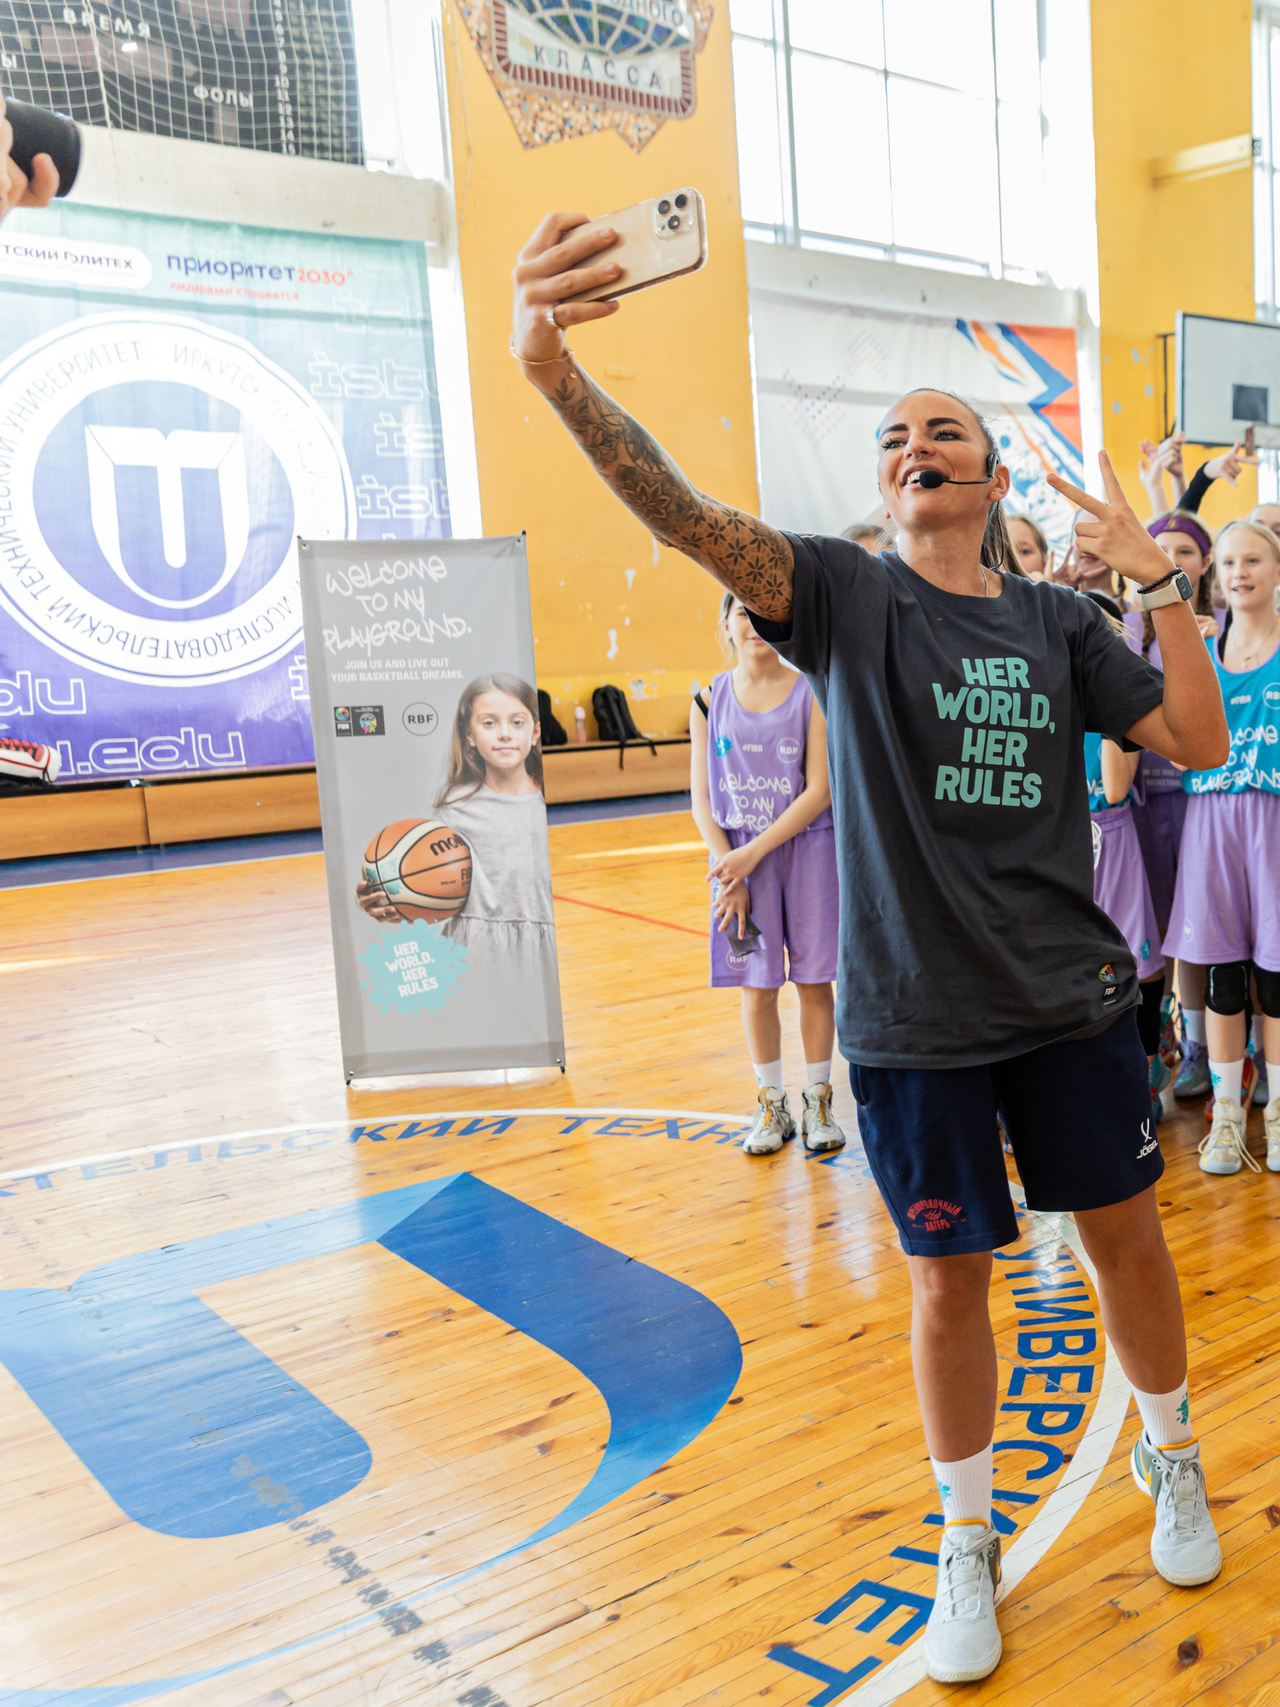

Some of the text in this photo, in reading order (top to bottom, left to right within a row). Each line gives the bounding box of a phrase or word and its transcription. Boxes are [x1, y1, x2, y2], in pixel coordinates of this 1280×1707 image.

[63, 8, 151, 38] ВРЕМЯ
[534, 45, 662, 89] КЛАССА
[193, 84, 252, 108] ФОЛЫ
[355, 586, 425, 617] TO MY
[322, 612, 473, 657] PLAYGROUND.
[345, 657, 450, 670] JOIN US AND LIVE OUT
[961, 657, 1031, 688] HER
[331, 671, 357, 682] YOUR
[360, 670, 420, 681] BASKETBALL
[407, 714, 434, 724] RBF
[932, 683, 1056, 734] WORLD,
[780, 746, 798, 755] RBF
[961, 727, 1029, 767] HER
[935, 765, 1042, 808] RULES
[752, 796, 774, 819] MY
[393, 940, 420, 957] HER
[384, 951, 435, 973] WORLD,
[402, 966, 428, 983] HER
[397, 976, 439, 997] RULES
